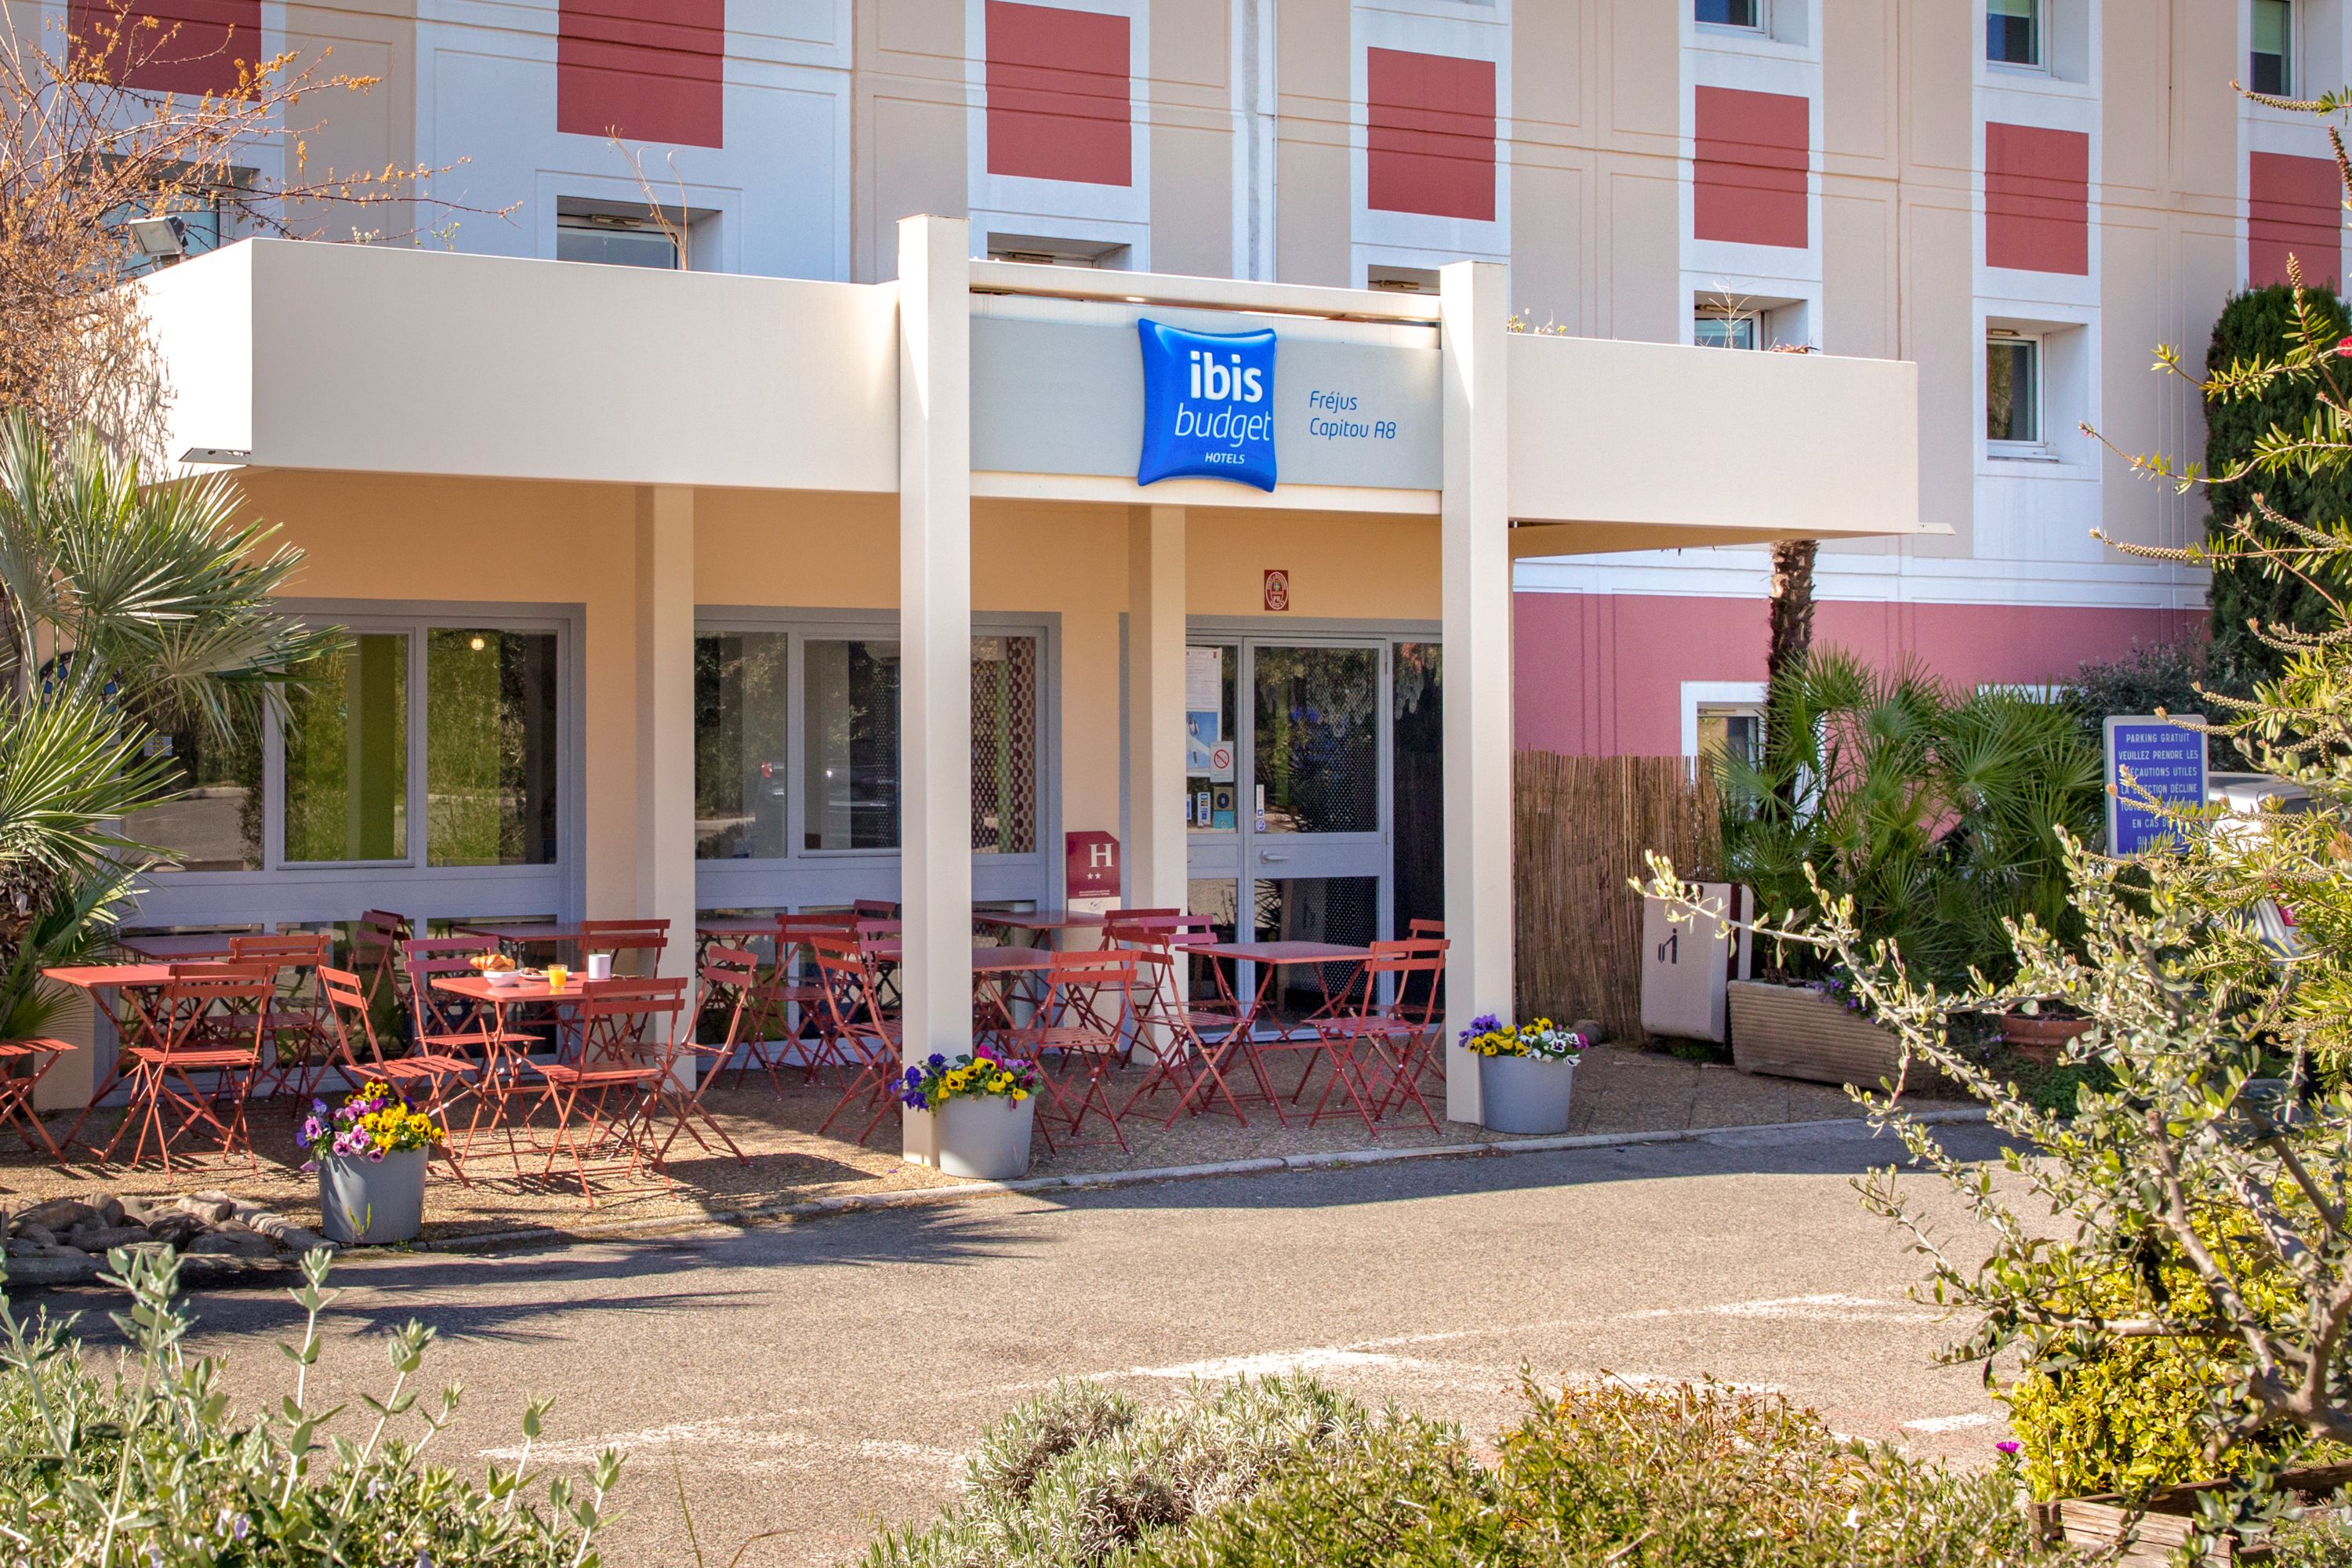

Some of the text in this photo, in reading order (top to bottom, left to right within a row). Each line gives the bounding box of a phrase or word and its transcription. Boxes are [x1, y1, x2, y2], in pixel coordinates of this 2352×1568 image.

[1190, 350, 1263, 403] ibis
[1310, 390, 1358, 414] Fréjus
[1174, 402, 1272, 448] budget
[1310, 418, 1396, 441] Capitou A8
[1204, 452, 1245, 464] HOTELS
[2125, 733, 2190, 743] PARKING GRATUIT
[2118, 750, 2198, 760] VEUILLEZ PRENDRE LES
[2121, 766, 2198, 777] ÉCAUTIONS UTILES
[2121, 782, 2198, 794] LA ECTION DÉCLINE
[2132, 818, 2142, 829] EN
[2144, 818, 2159, 828] CAS
[1088, 843, 1114, 868] H
